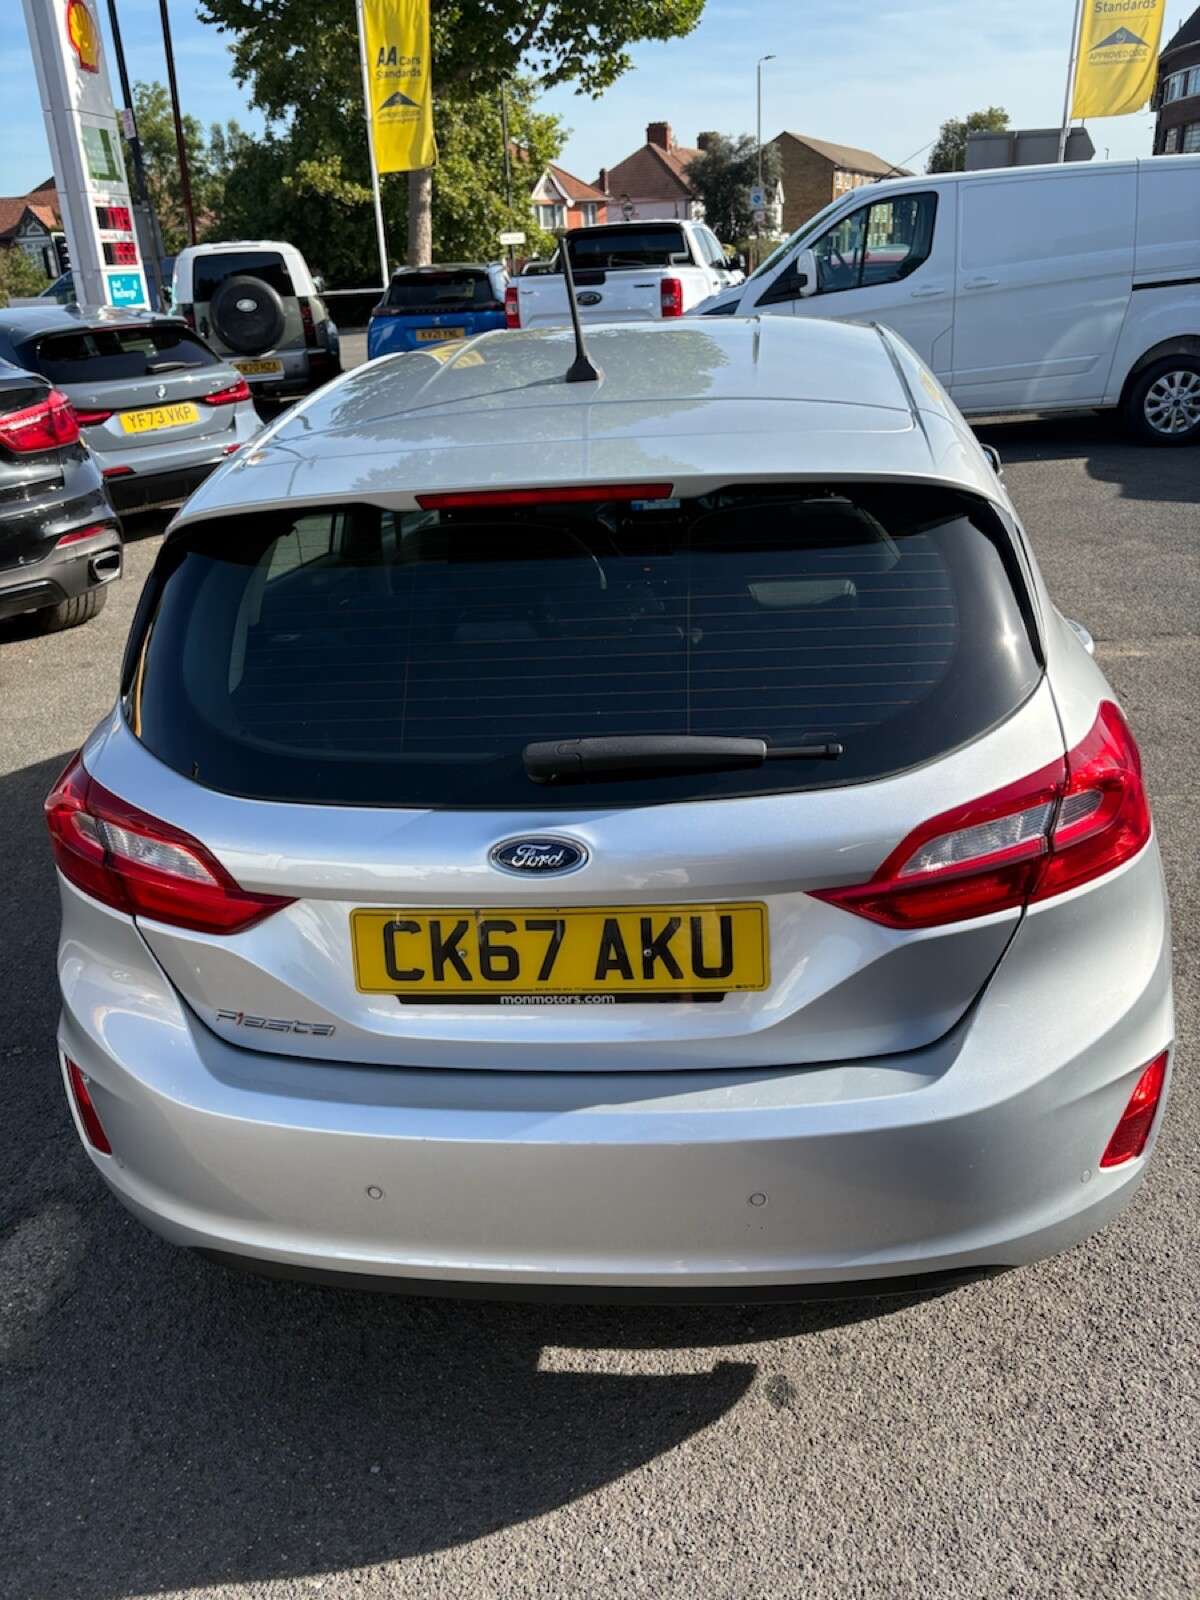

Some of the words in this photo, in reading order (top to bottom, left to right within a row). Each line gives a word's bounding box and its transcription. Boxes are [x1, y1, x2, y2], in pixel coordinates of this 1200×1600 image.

[1095, 0, 1156, 12] Standards
[376, 46, 397, 66] AA
[376, 68, 422, 79] Standards
[127, 409, 165, 429] YF73
[166, 405, 192, 423] VKP
[511, 844, 565, 867] Ford
[383, 919, 566, 982] CK67
[594, 915, 733, 981] AKU
[500, 993, 616, 1005] monmotors.com
[216, 1007, 336, 1037] Fiesta
